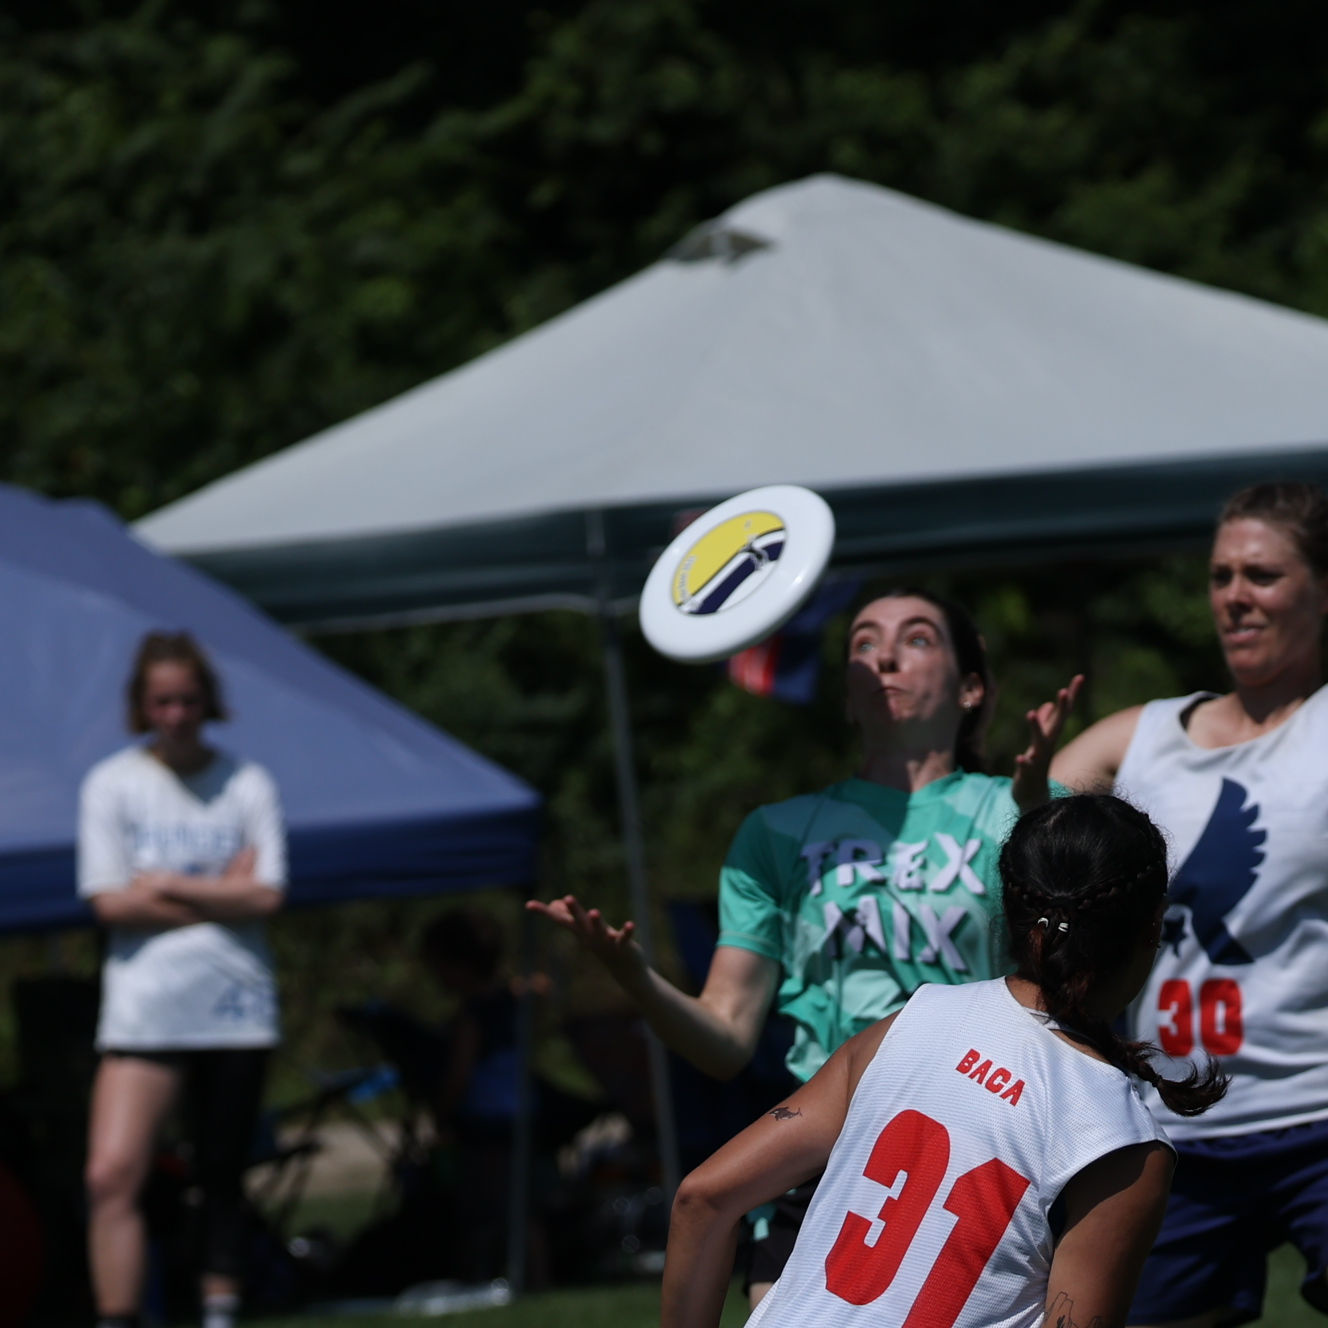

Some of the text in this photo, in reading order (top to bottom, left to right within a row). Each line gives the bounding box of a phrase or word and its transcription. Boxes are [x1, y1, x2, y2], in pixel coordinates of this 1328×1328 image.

[822, 896, 968, 971] MIX
[1158, 979, 1244, 1057] 30
[956, 1049, 1025, 1106] BACA
